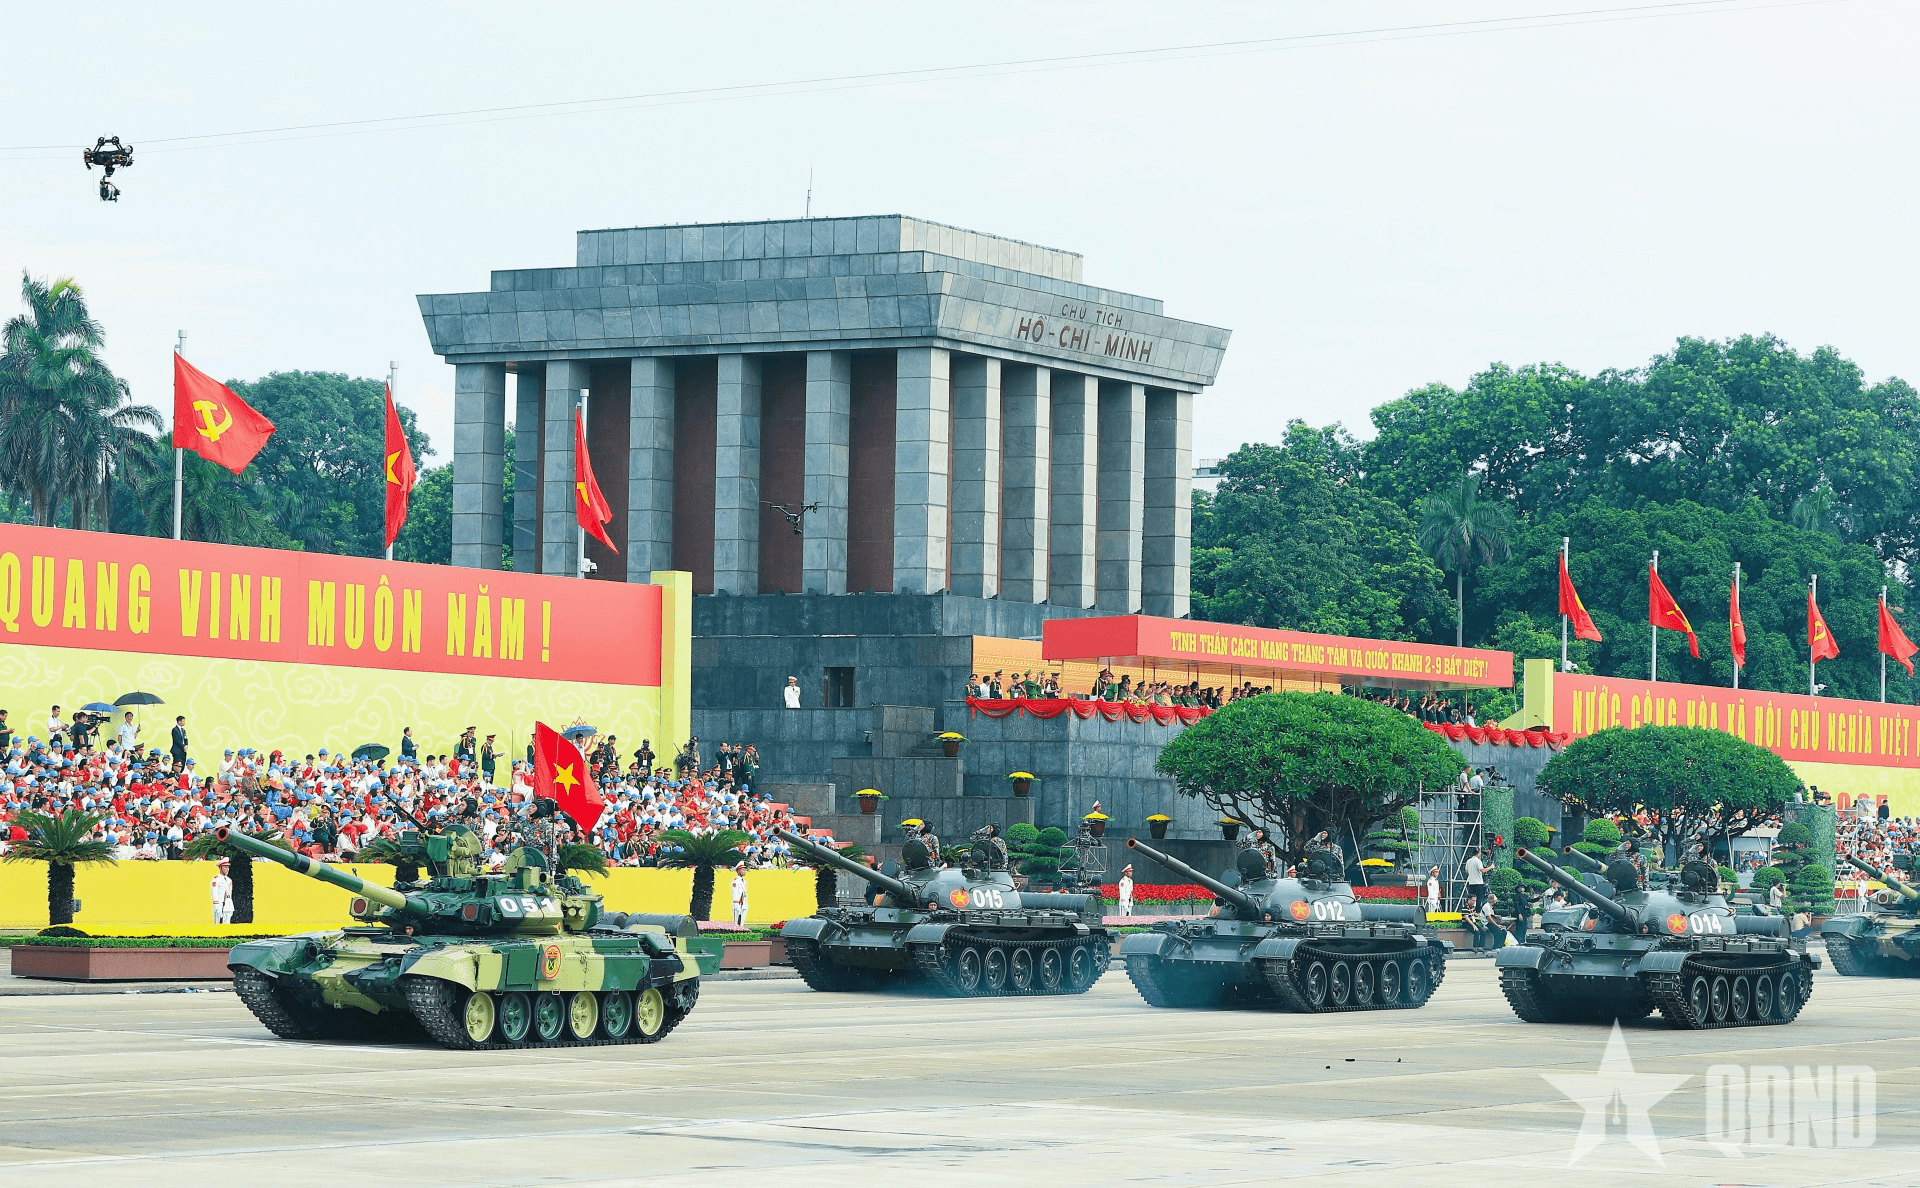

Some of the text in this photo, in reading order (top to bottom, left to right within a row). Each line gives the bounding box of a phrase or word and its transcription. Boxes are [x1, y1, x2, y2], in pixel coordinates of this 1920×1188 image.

[0, 552, 150, 634] QUANG
[179, 568, 281, 643] VINH
[308, 574, 422, 653] MUÔN
[446, 583, 525, 660] NĂM
[1170, 631, 1197, 653] TINH
[1200, 630, 1229, 656] THẦN
[1231, 634, 1258, 659] CÁCH
[1260, 640, 1289, 664] MẠNG
[1291, 641, 1325, 665] THÁNG
[1327, 644, 1348, 667] TÁM
[1350, 646, 1363, 668] VÀ
[1365, 646, 1390, 670] QUỐC
[1392, 650, 1423, 673] KHÁNH
[1444, 653, 1462, 676] BẤT
[1572, 685, 1621, 735] NƯỚC
[1790, 701, 1820, 751] CHỦ
[1828, 708, 1872, 754] NGHĨA
[1879, 711, 1910, 763] VIỆT
[500, 897, 556, 913] 051
[972, 889, 1003, 909] 015
[1313, 900, 1346, 921] 012
[1689, 912, 1722, 934] 014
